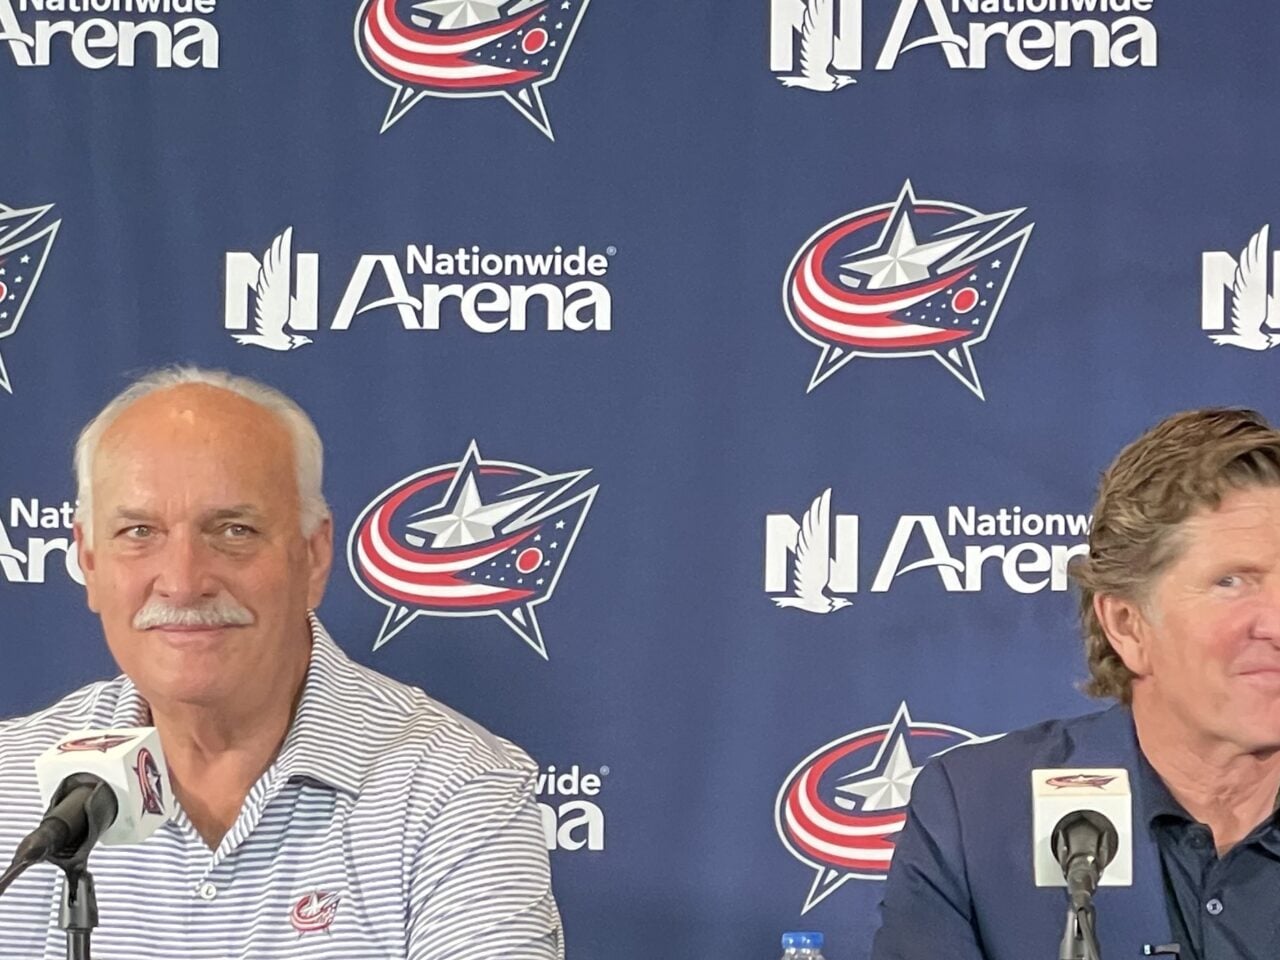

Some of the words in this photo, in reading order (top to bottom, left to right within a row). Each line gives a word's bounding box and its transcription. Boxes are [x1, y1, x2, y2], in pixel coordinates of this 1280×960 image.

[876, 0, 1157, 70] Arena
[331, 254, 611, 333] Arena
[10, 498, 79, 528] Nat
